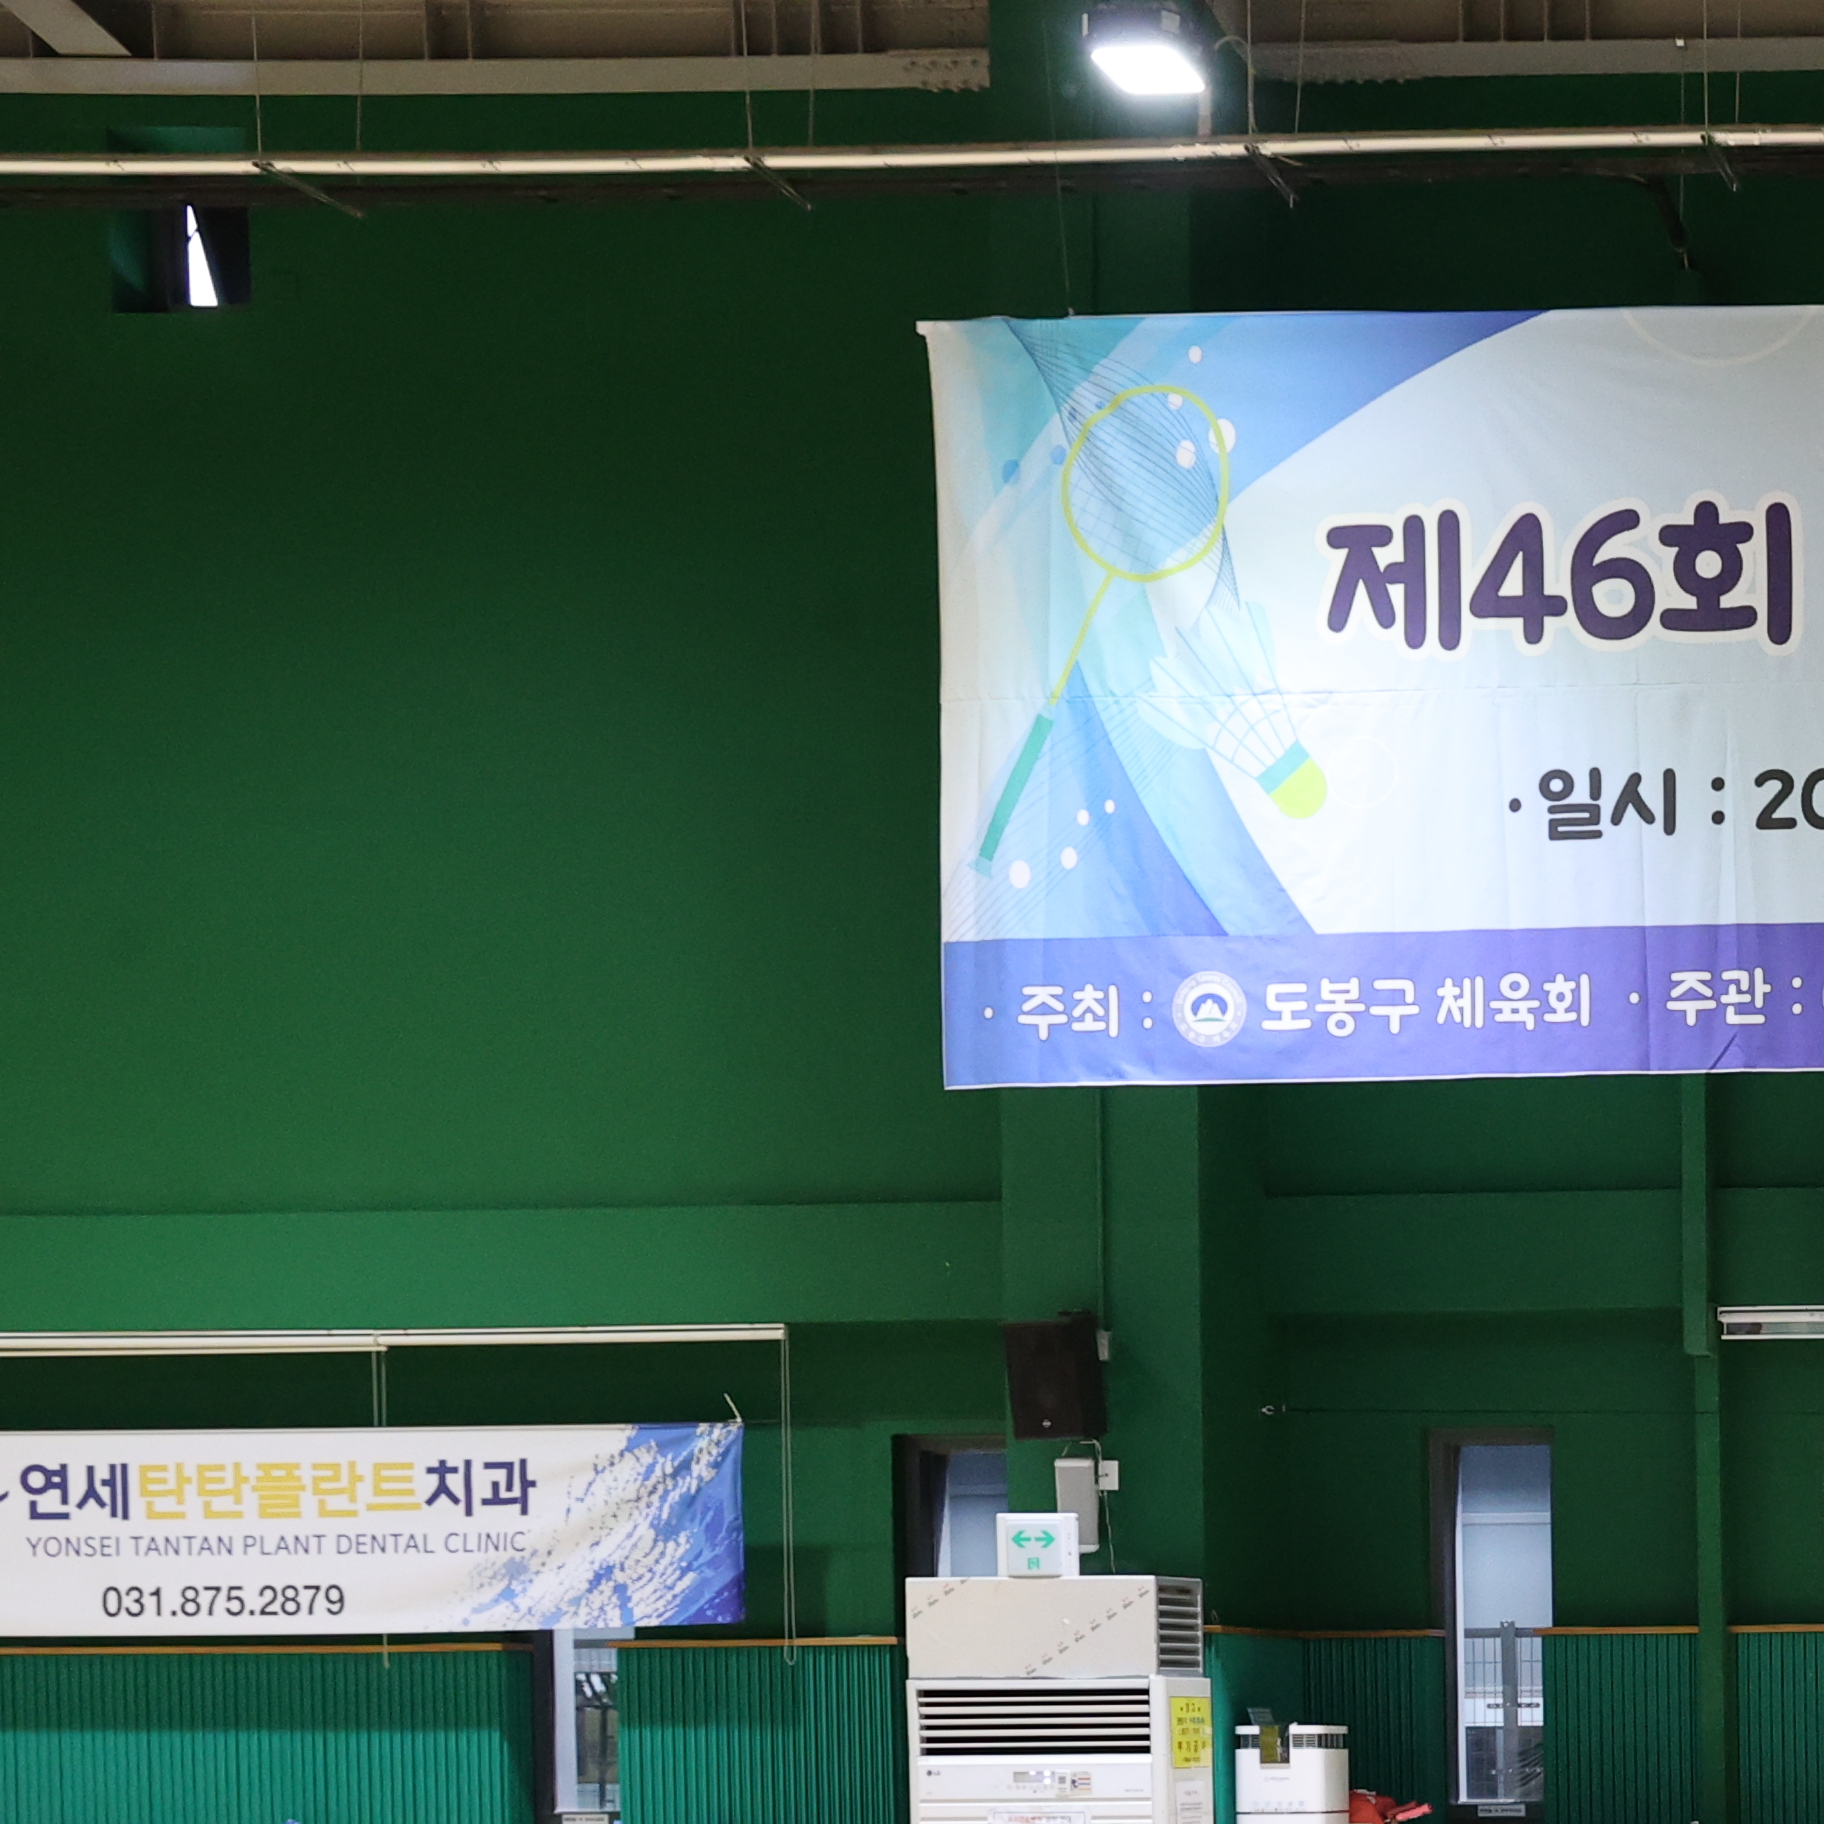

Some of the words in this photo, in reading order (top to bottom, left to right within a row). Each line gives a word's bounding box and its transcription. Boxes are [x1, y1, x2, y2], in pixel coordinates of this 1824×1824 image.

[1326, 500, 1793, 651] 제46회
[1017, 983, 1119, 1041] 주최
[1260, 976, 1420, 1037] 도봉구
[1436, 972, 1590, 1031] 체육회
[1666, 967, 1771, 1026] 주관
[19, 1459, 537, 1520] 연세탄탄플란트치과
[26, 1536, 120, 1558] YONSEI
[129, 1535, 233, 1557] TANTAN
[243, 1534, 327, 1556] PLANT
[336, 1533, 435, 1555] DENTAL
[444, 1531, 527, 1554] CLINIC
[102, 1584, 345, 1618] 031.875.2879
